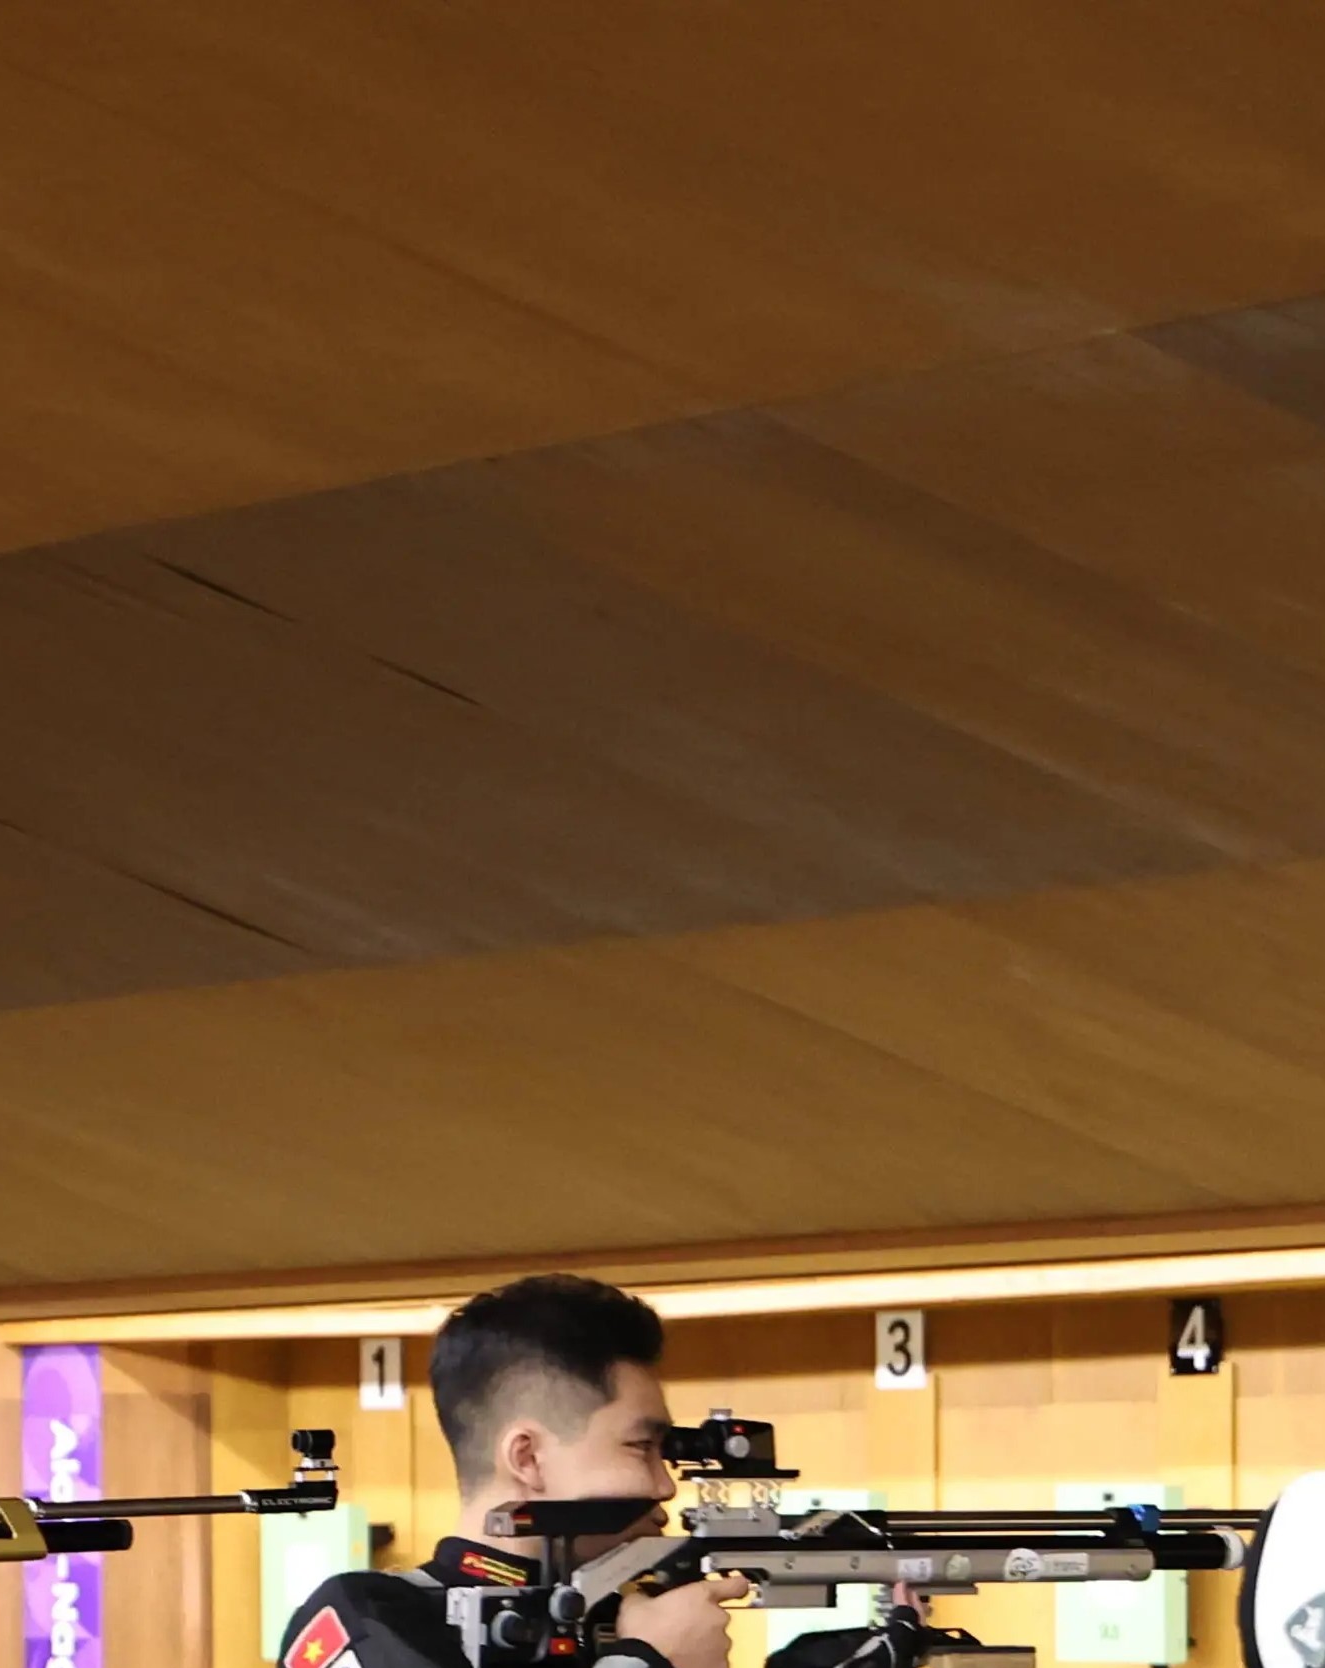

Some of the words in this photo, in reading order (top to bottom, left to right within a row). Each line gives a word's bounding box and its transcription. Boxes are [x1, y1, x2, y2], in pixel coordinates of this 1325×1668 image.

[887, 1319, 911, 1377] 3
[1177, 1305, 1210, 1371] 4
[371, 1345, 385, 1398] 1
